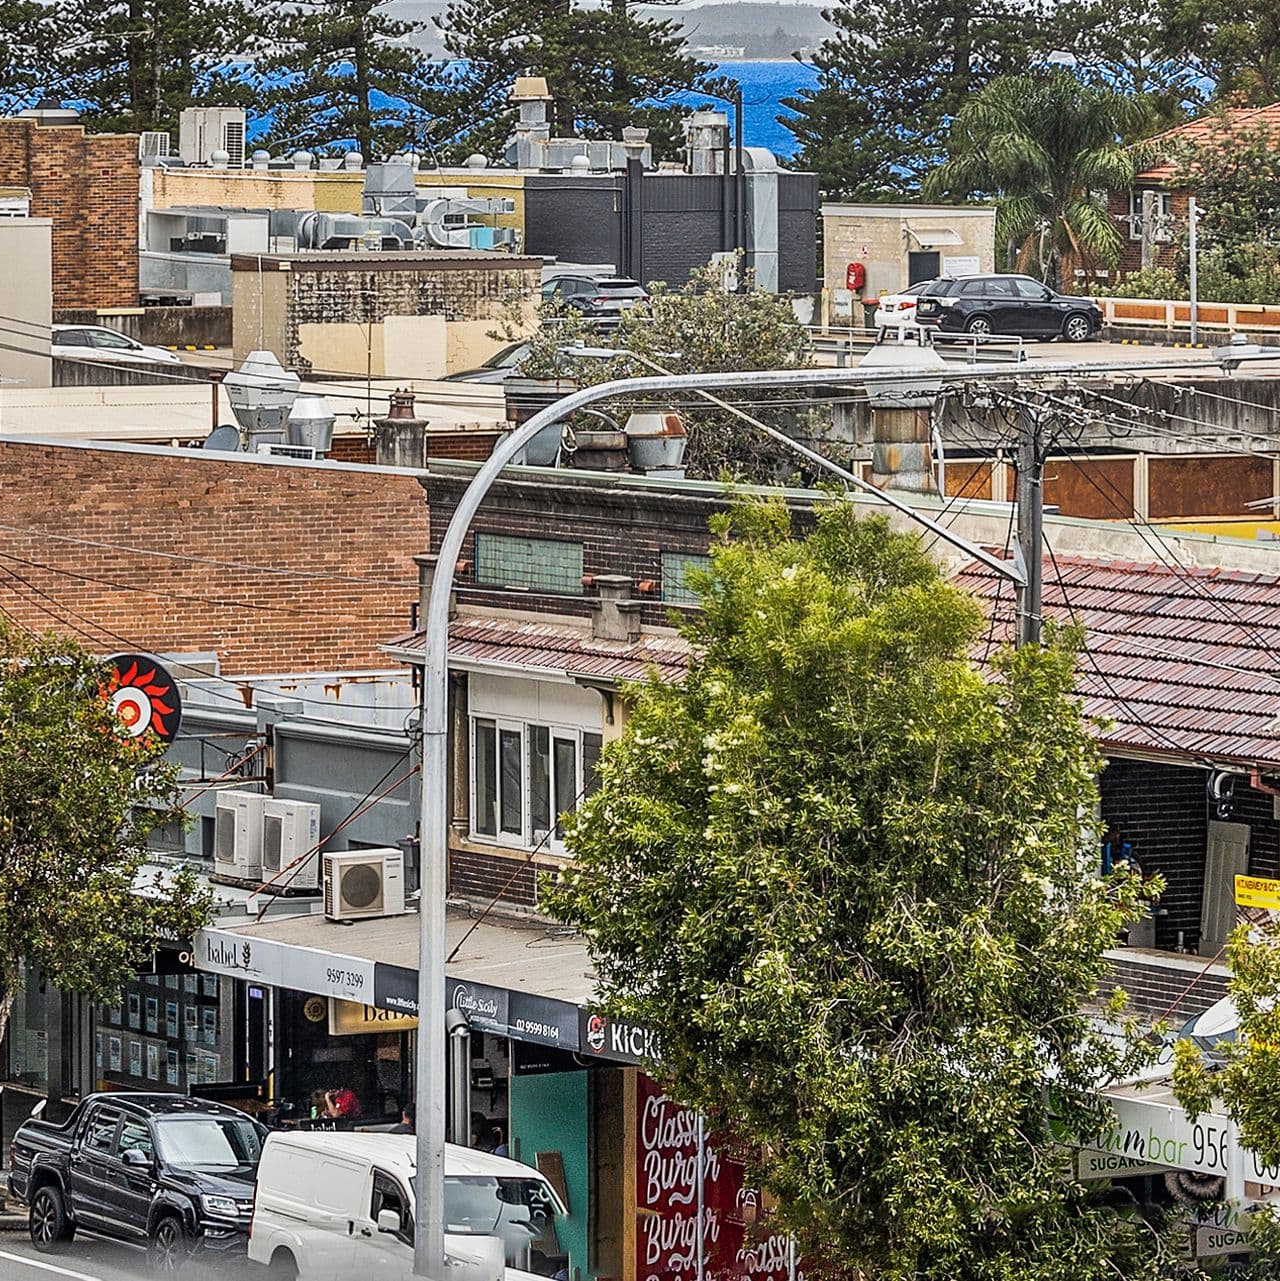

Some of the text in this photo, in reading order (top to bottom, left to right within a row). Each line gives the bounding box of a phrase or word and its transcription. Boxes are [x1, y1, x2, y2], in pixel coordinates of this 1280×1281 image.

[207, 938, 237, 966] babel
[326, 967, 364, 989] 9597 3299
[516, 1018, 560, 1039] 02 9599 8164
